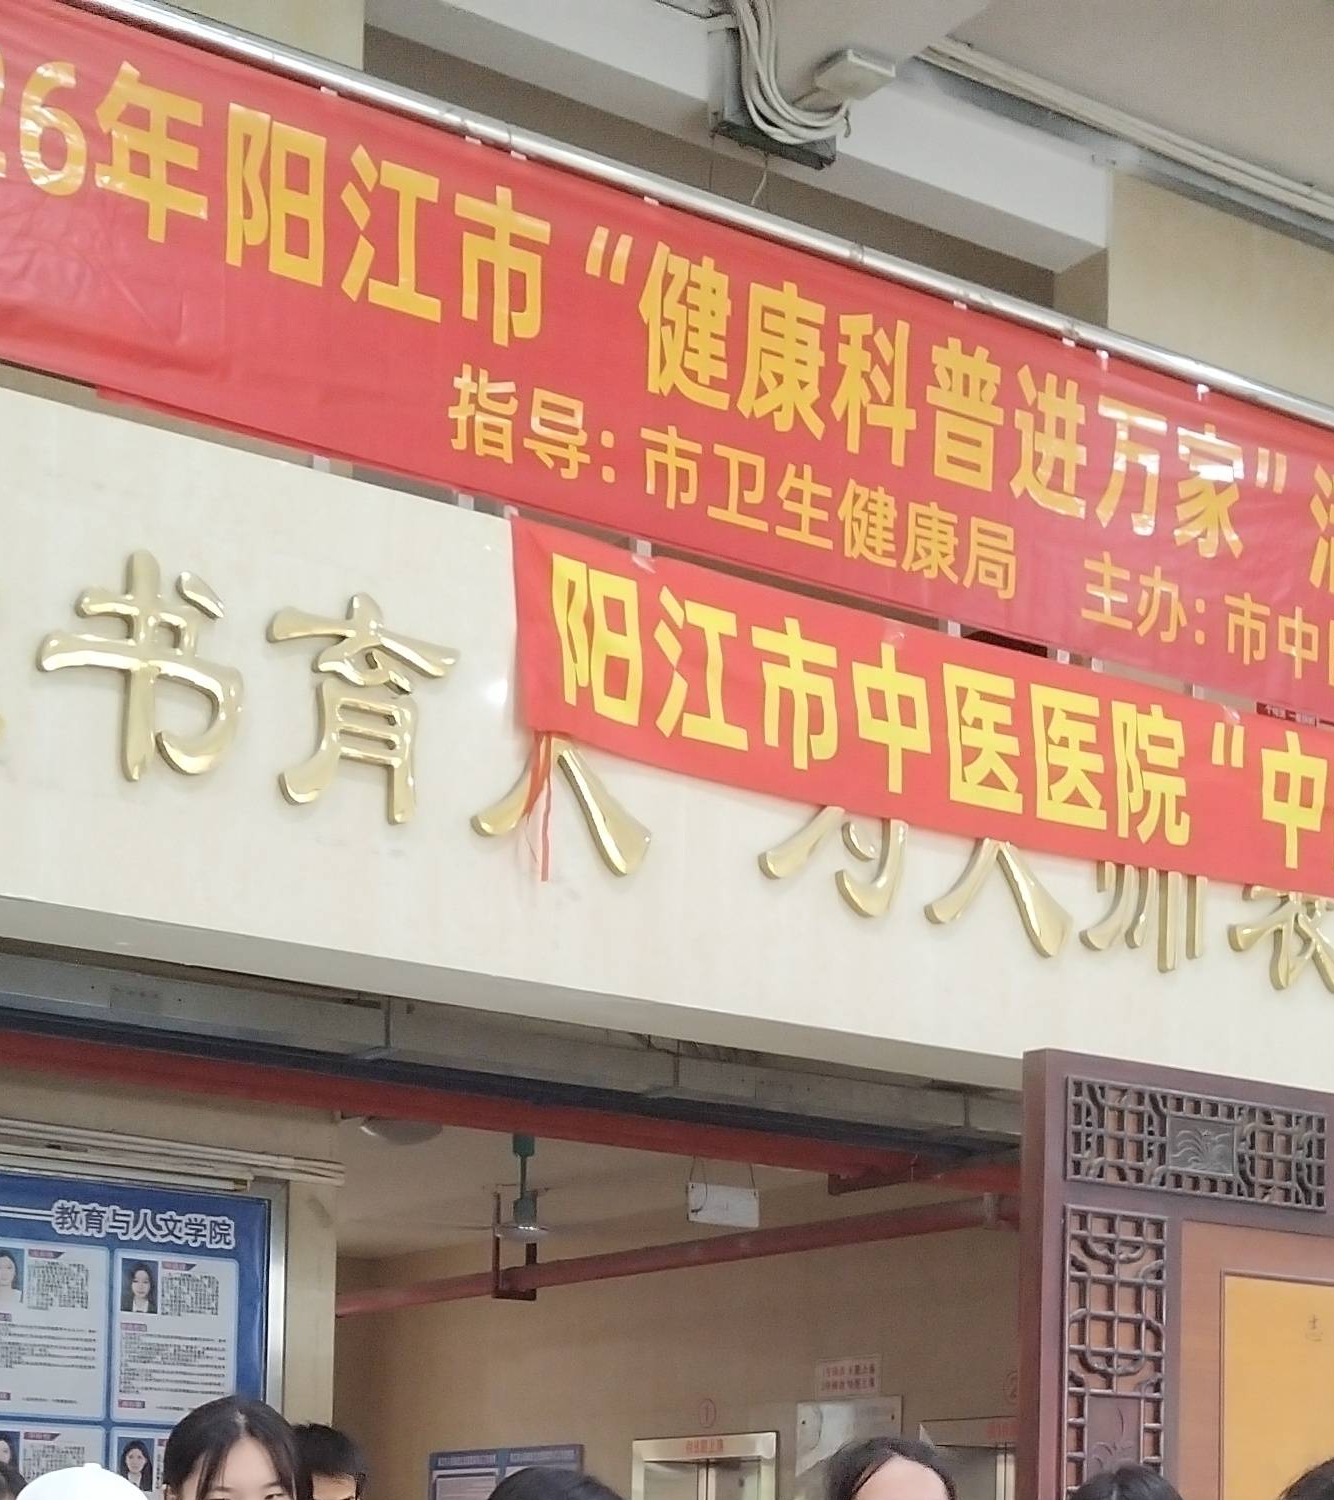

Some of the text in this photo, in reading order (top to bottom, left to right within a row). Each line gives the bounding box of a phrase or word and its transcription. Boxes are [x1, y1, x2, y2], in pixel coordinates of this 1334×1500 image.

[450, 361, 1018, 600] 指导：市卫生健康局
